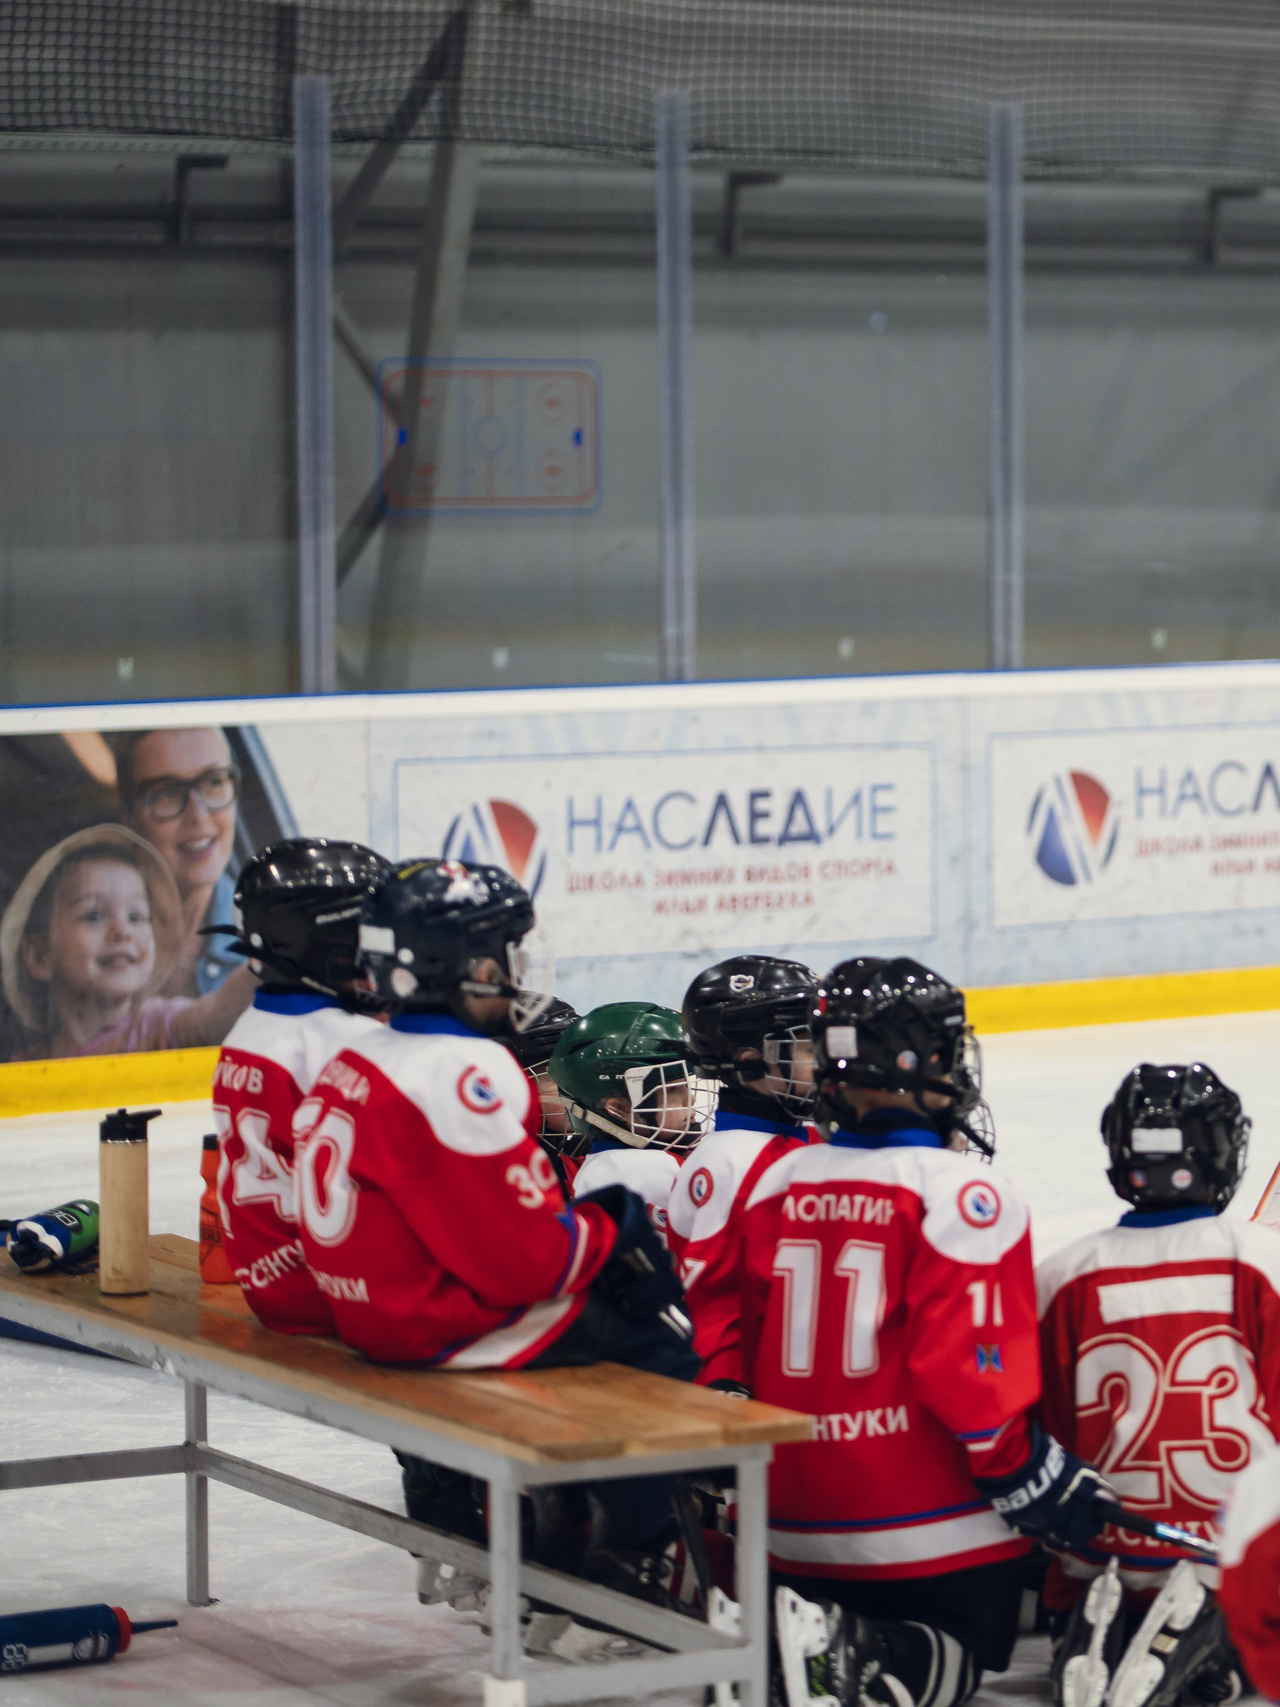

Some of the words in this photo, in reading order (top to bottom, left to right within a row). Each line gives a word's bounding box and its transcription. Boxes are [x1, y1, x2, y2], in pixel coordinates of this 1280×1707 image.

[566, 783, 898, 853] НАСЛЕДИЕ
[506, 1146, 558, 1210] 30
[773, 1238, 888, 1379] 11
[1075, 1324, 1278, 1511] 23
